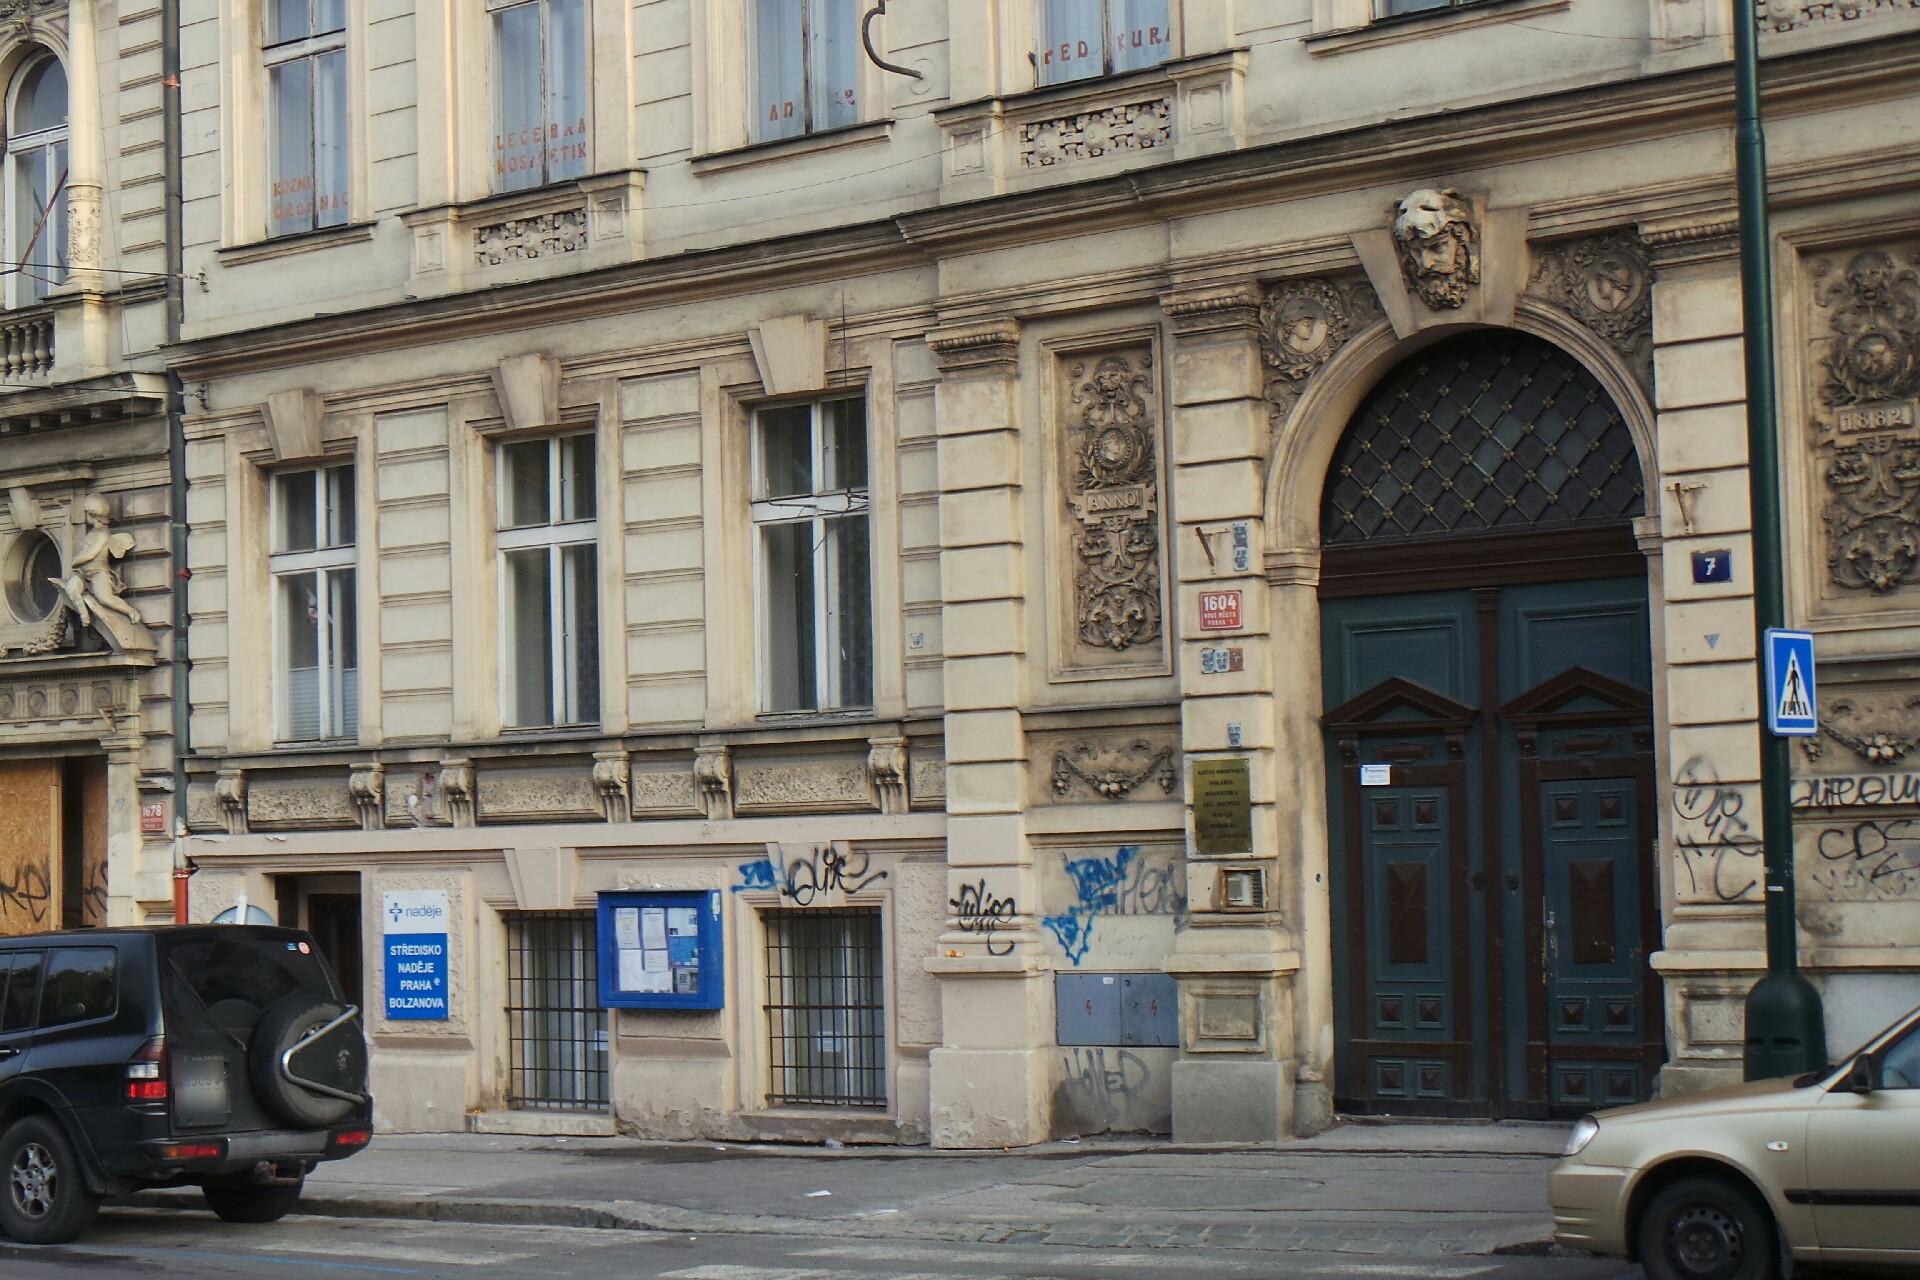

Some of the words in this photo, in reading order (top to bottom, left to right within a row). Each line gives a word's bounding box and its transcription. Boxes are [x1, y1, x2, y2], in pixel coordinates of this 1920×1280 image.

[1845, 408, 1903, 430] 1882
[1088, 492, 1137, 511] ANNO
[1704, 557, 1716, 576] 7
[1203, 594, 1237, 611] 1604
[142, 804, 162, 817] 1678
[405, 904, 442, 919] naděje
[390, 943, 442, 956] STŘEDISKO
[398, 960, 435, 973] NADĚJE
[400, 980, 432, 990] PRAHA
[389, 997, 444, 1009] BOLZANOVA
